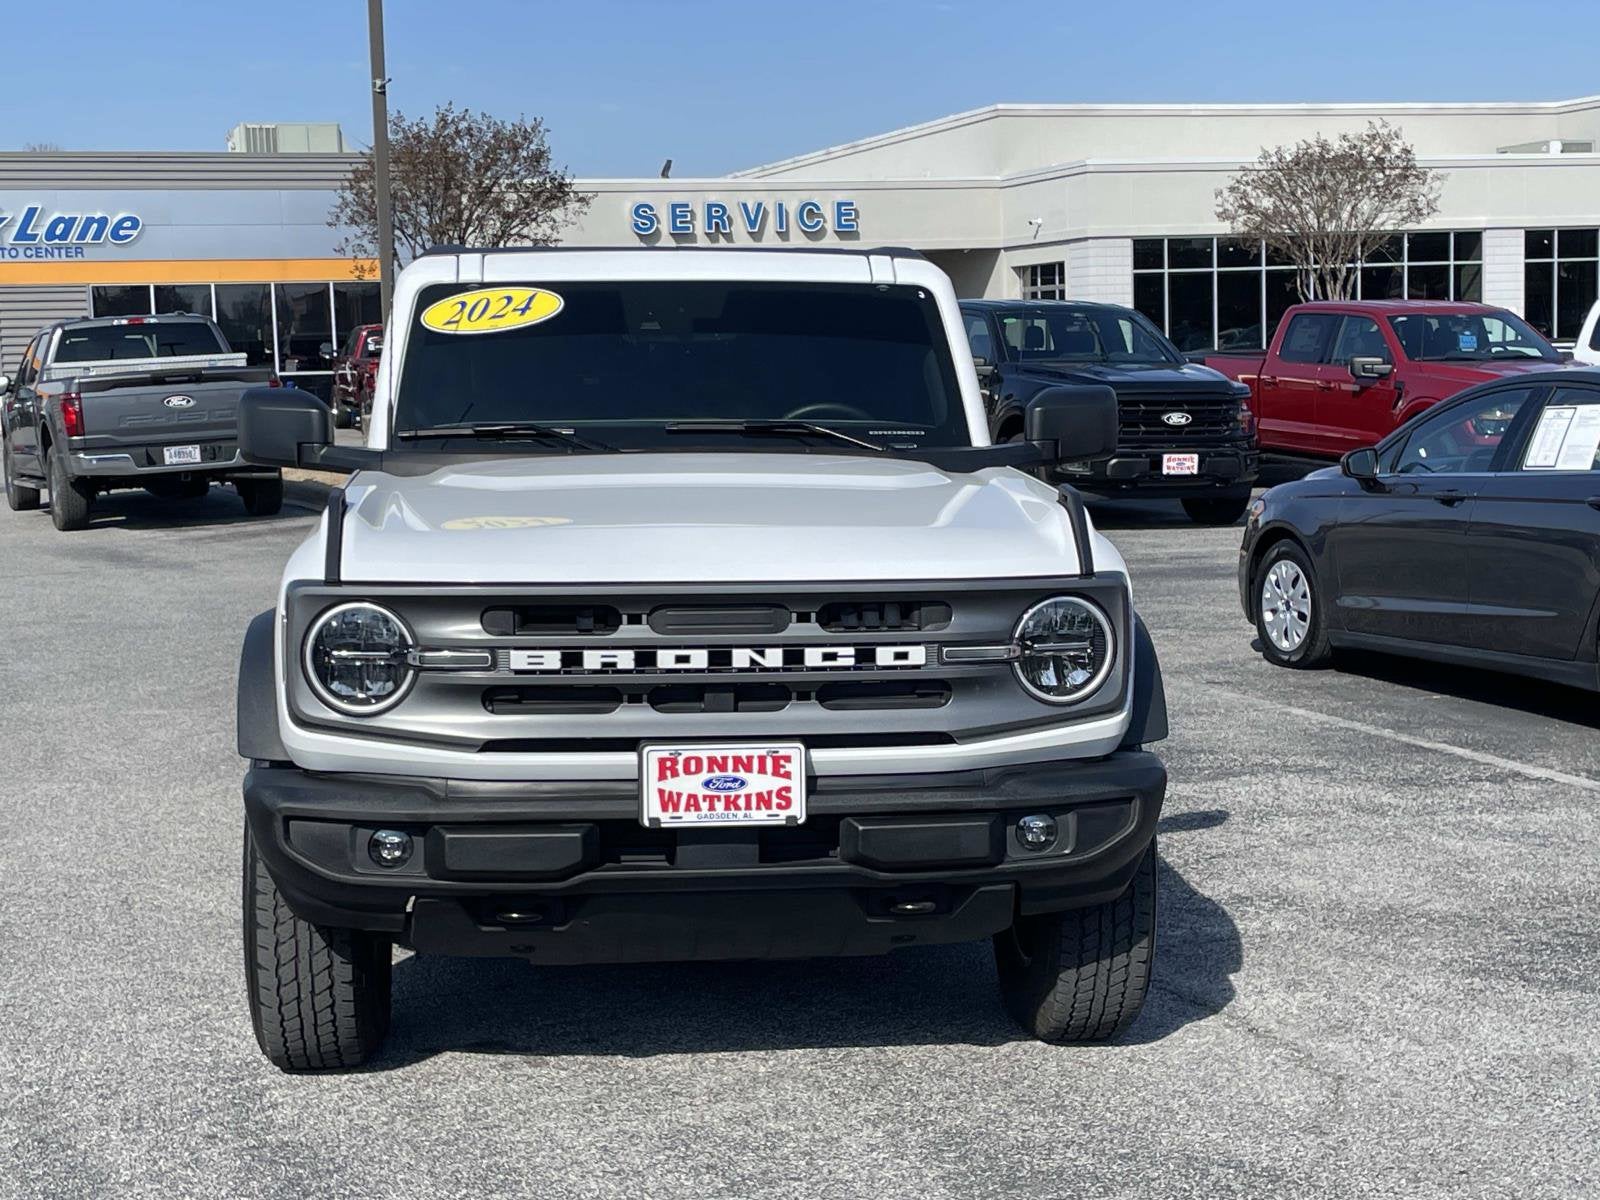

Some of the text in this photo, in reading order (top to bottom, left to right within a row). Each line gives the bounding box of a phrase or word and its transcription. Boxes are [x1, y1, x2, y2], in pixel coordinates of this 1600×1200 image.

[11, 205, 142, 244] Lane
[632, 200, 858, 234] SERVICE
[23, 246, 85, 258] CENTER
[442, 292, 538, 326] 2024
[166, 396, 194, 407] Ford
[509, 645, 926, 670] BRONCO
[657, 755, 792, 782] RONNIE
[707, 777, 743, 790] Ford
[657, 786, 792, 813] WATKINS
[696, 811, 754, 820] GADSDEN, AL
